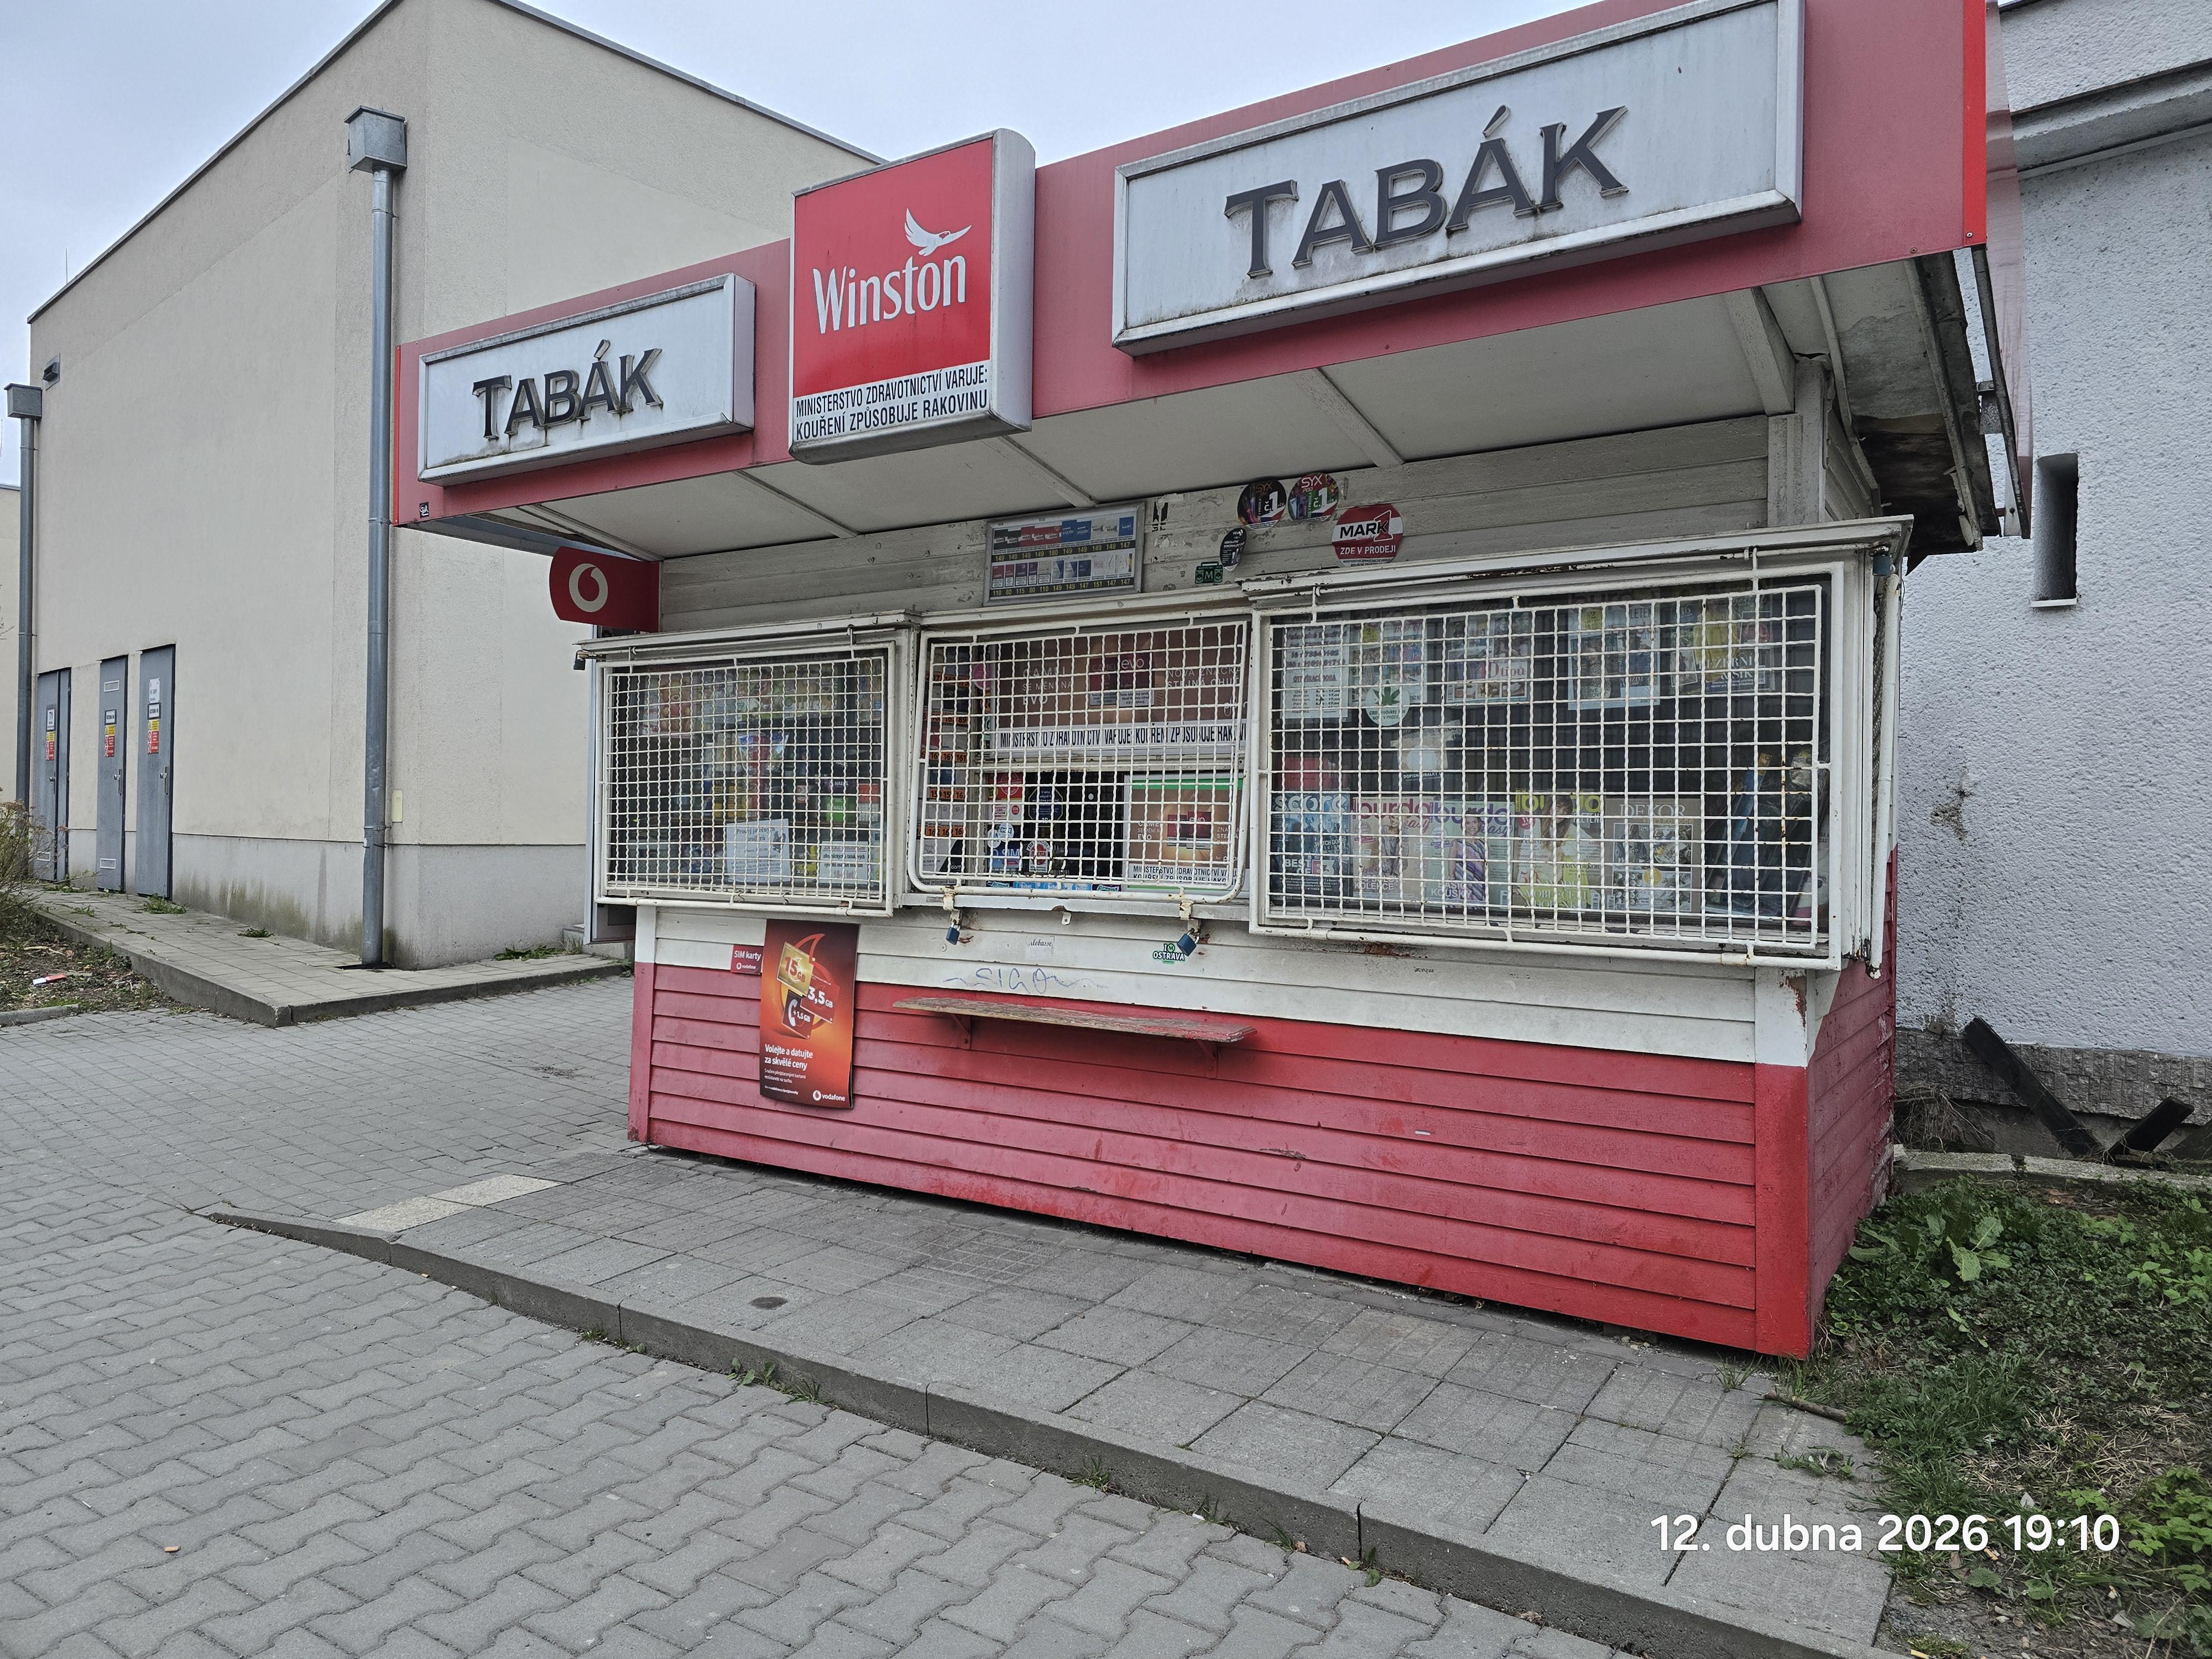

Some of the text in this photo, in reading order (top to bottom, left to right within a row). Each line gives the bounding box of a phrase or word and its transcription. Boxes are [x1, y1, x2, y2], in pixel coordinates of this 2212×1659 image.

[1224, 105, 1629, 279] TABÁK
[812, 254, 967, 335] Winston
[472, 339, 663, 441] TABÁK
[796, 364, 988, 418] MINISTERSTVO ZDRAVOTNICTVÍ VARUJE:
[796, 389, 988, 441] KOUŘENÍ ZPŮSOBUJE RAKOVINU
[1301, 474, 1323, 489] SYX
[1339, 520, 1389, 539] MARK
[1340, 545, 1396, 555] ZDE V PRODEJI
[1205, 571, 1213, 580] M
[1035, 681, 1056, 691] MĚN
[1274, 795, 1348, 813] score
[1434, 801, 1508, 824] buda
[1285, 859, 1312, 868] BEST
[734, 950, 761, 961] SIM karty
[1153, 951, 1185, 961] OSTRAVA
[784, 956, 806, 983] 15 GB
[807, 986, 833, 1008] 3,5 GB
[804, 1014, 811, 1022] GB
[765, 1044, 785, 1056] Volejte
[791, 1048, 813, 1060] datujte
[772, 1057, 791, 1067] skvělé
[792, 1061, 807, 1071] ceny
